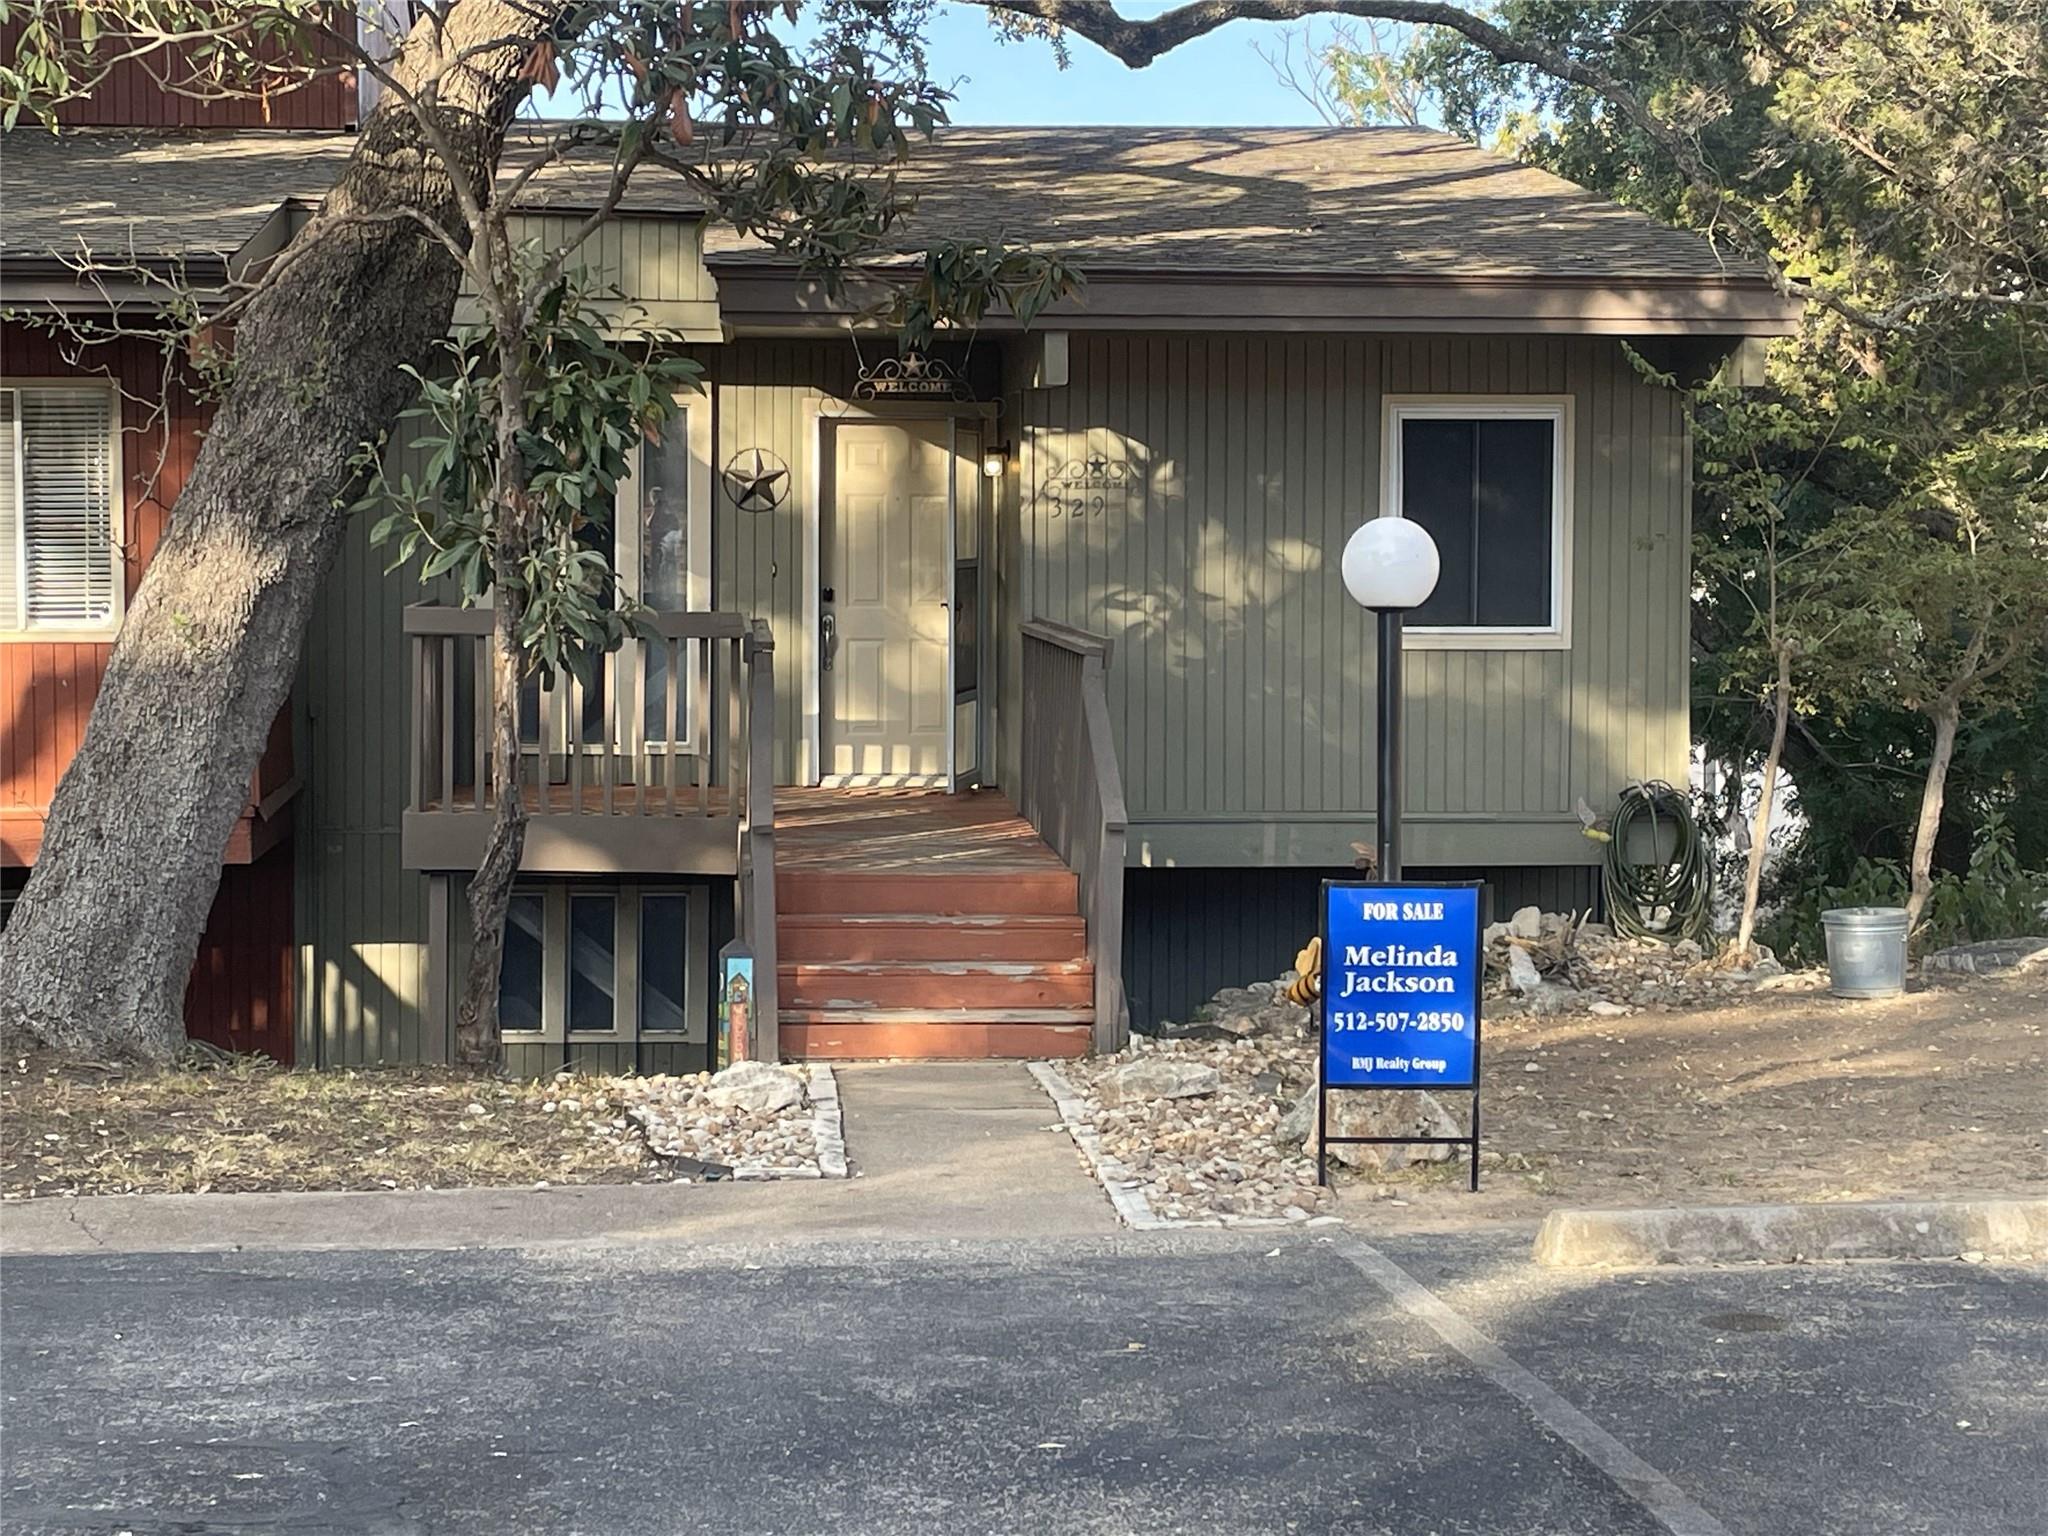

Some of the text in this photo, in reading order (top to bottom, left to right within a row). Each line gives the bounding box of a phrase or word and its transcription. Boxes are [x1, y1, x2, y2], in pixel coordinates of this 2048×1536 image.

[873, 381, 952, 393] WELCOME
[1050, 496, 1105, 518] 329
[1363, 902, 1444, 921] FOR SALE
[1344, 945, 1458, 967] Melinda
[1340, 971, 1455, 998] Jackson
[1334, 1012, 1465, 1032] 512-507-2850
[1376, 1057, 1410, 1073] Realty
[1412, 1057, 1447, 1073] Group
